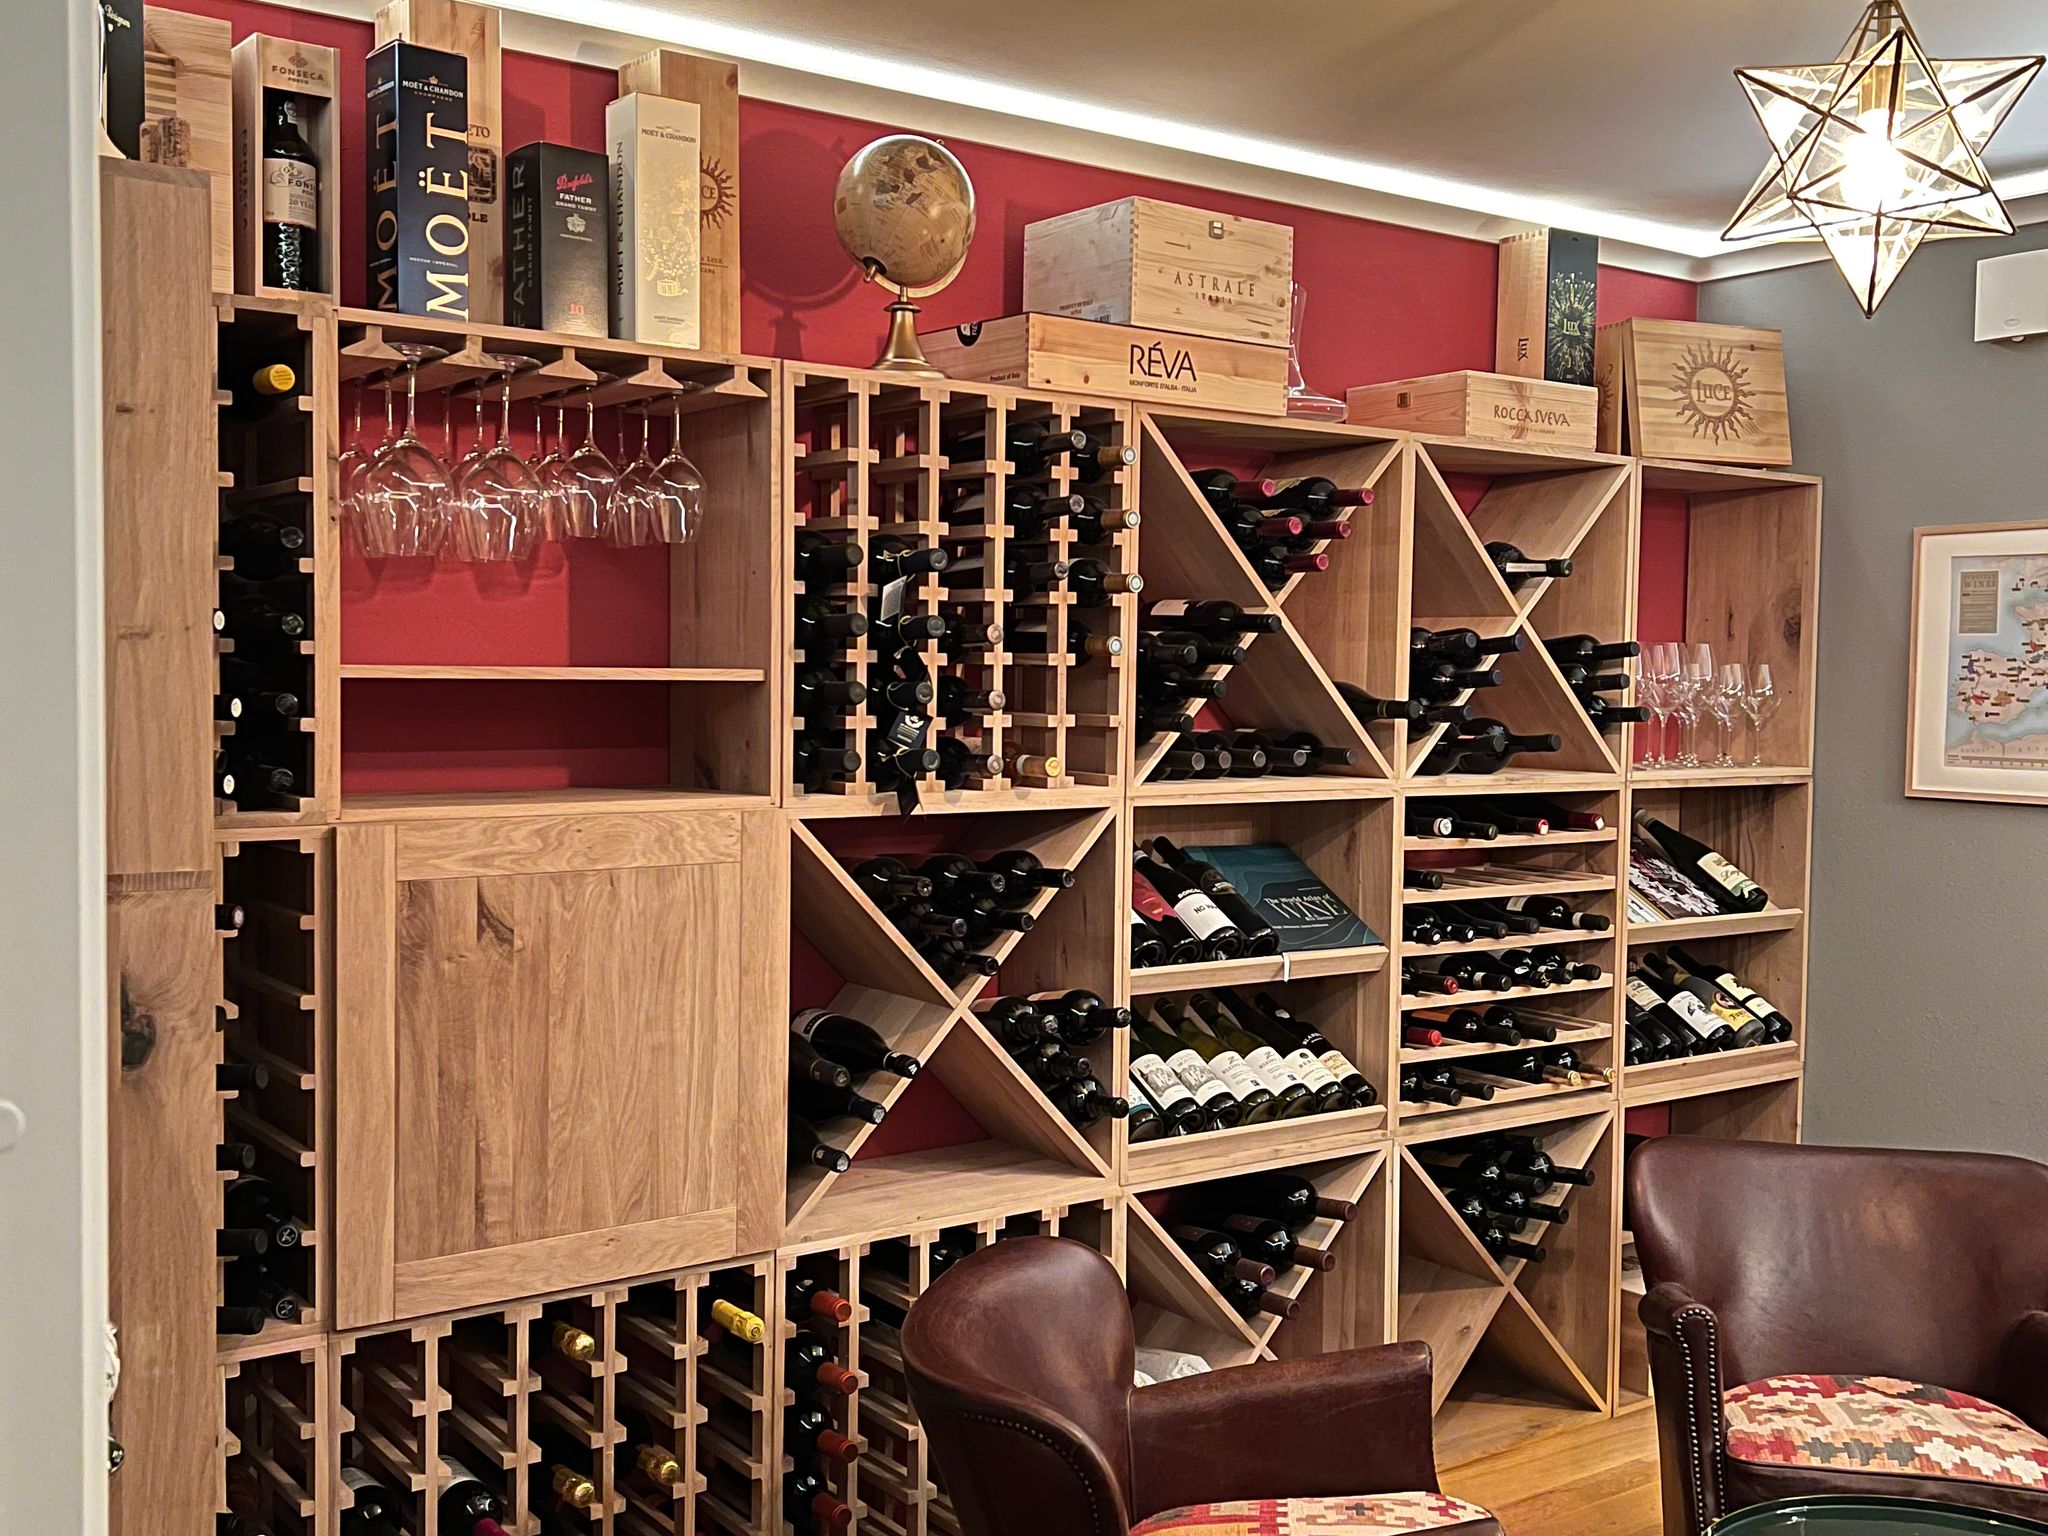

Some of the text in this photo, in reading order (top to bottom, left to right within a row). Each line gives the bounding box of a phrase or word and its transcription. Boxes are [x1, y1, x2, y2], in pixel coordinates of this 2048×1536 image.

[272, 65, 324, 81] FONSECA
[287, 77, 309, 85] PORTO
[402, 80, 422, 90] MOËT
[430, 85, 464, 99] CHANDON
[468, 124, 490, 138] ETO
[666, 132, 696, 144] CHANDON
[616, 141, 624, 227] CHANDON
[701, 184, 717, 200] CE
[559, 193, 592, 205] FATHER
[373, 113, 398, 312] MOËT
[418, 112, 469, 323] MOËT
[512, 160, 526, 328] FATHER
[1174, 271, 1255, 297] ASTRALE
[1195, 291, 1233, 305] ITALIA
[1130, 341, 1197, 382] RÉVA
[1129, 379, 1159, 389] MONFORTE
[1160, 382, 1178, 391] D'ALBA
[1181, 385, 1197, 393] ITALIA
[1494, 404, 1571, 427] ROCCA SVEVA
[1263, 893, 1335, 905] The World Atlas of
[1268, 899, 1349, 920] WINE
